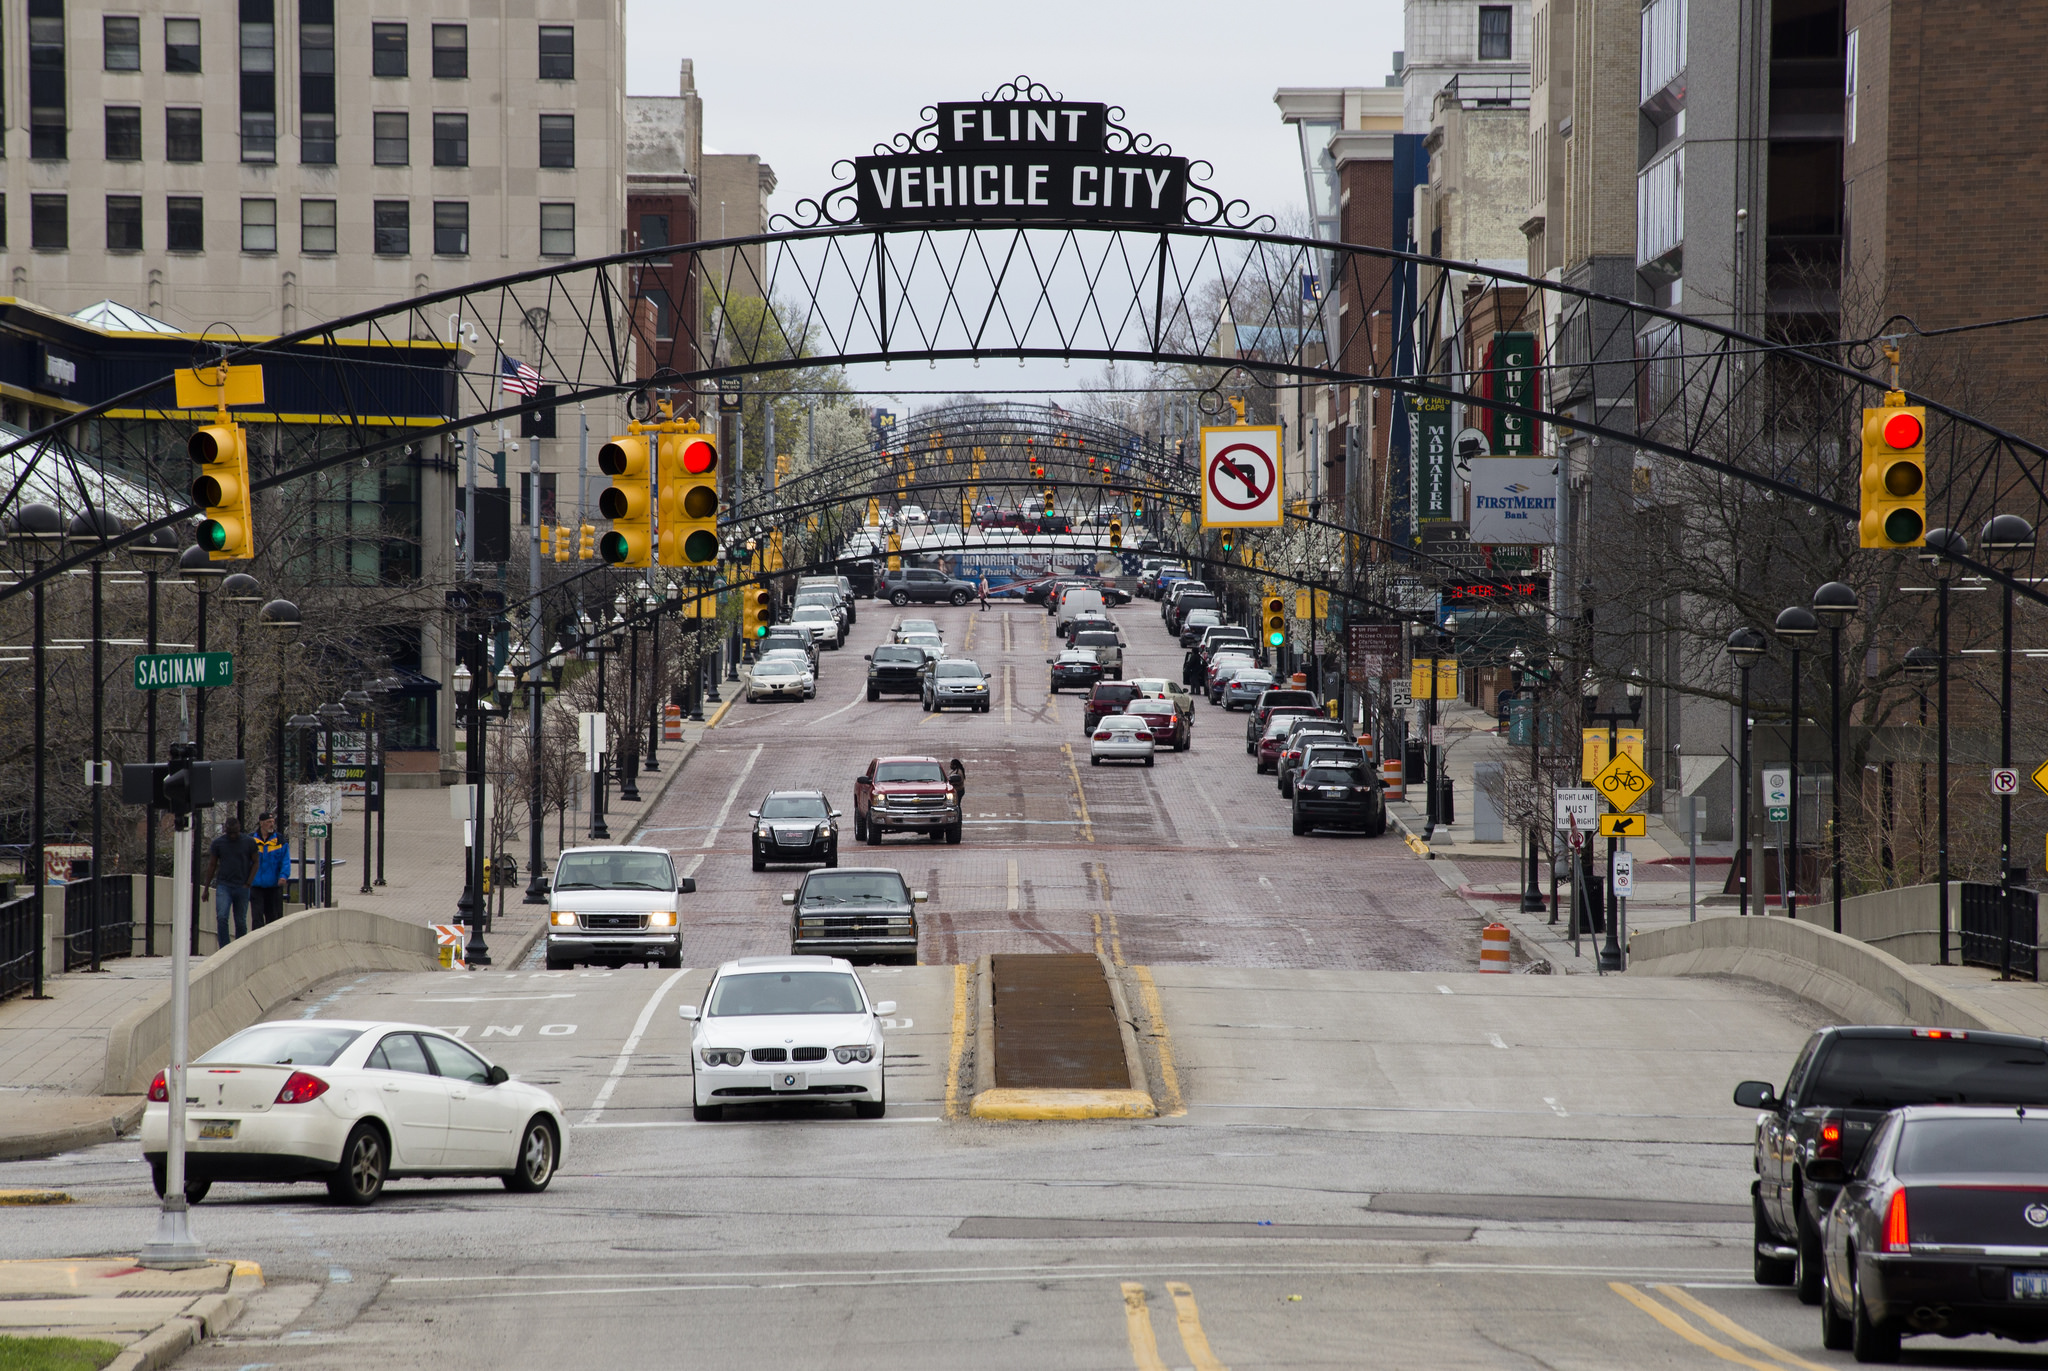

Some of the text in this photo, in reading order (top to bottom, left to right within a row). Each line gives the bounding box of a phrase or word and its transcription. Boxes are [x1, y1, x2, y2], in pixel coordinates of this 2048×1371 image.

[953, 109, 1087, 141] FLINT
[870, 165, 1171, 208] VEHICLE CITY
[1411, 397, 1430, 405] NW
[880, 415, 894, 426] M
[1504, 511, 1528, 519] Bank
[962, 554, 1089, 566] HONORING ALL VETERANS
[962, 568, 978, 576] We
[981, 568, 1012, 576] Thank
[139, 657, 229, 685] SAGINAW ST
[1394, 694, 1412, 706] 25
[332, 769, 366, 779] UBWAY
[1565, 805, 1587, 813] MUST
